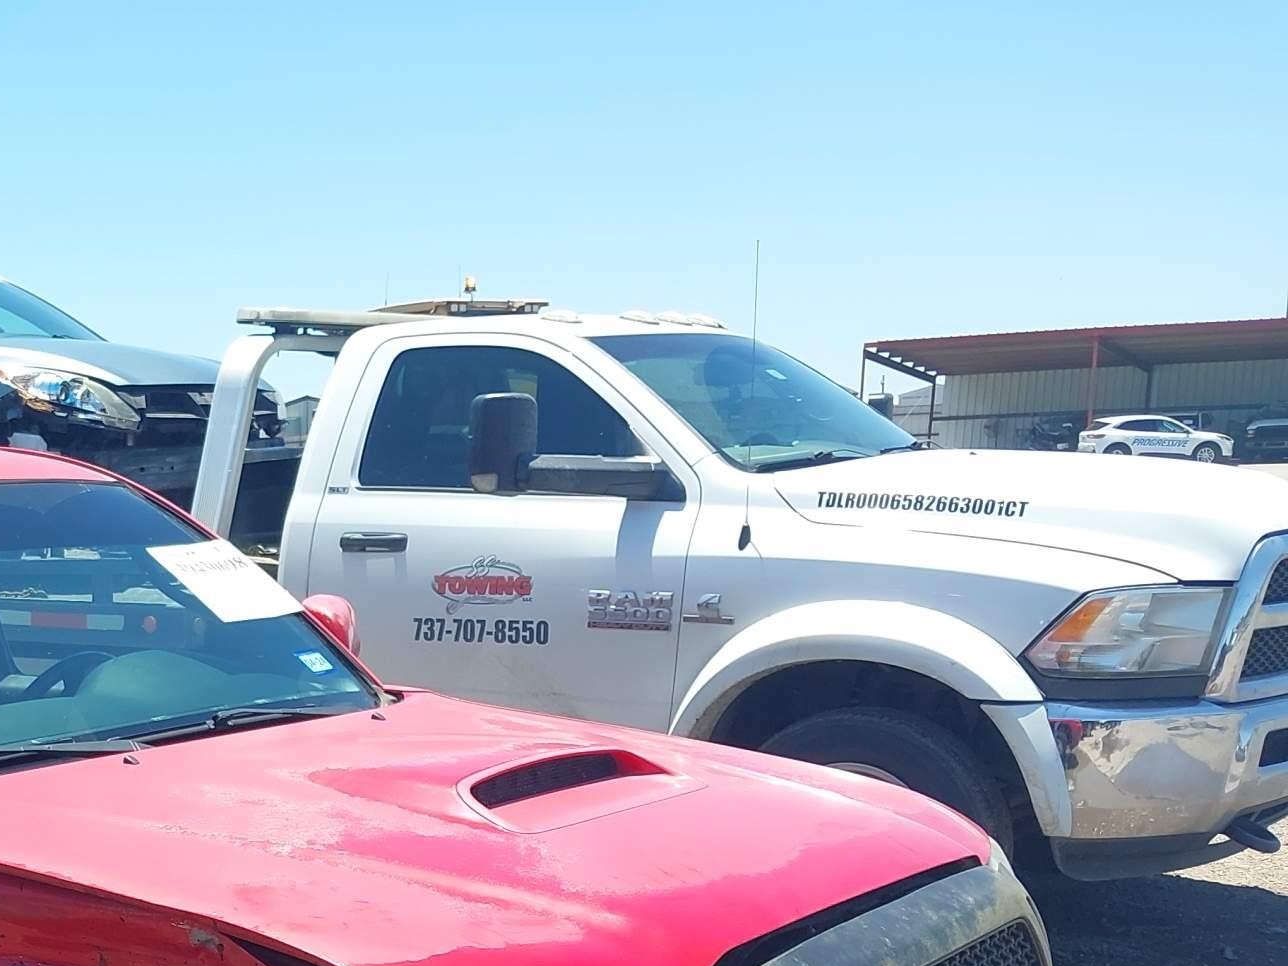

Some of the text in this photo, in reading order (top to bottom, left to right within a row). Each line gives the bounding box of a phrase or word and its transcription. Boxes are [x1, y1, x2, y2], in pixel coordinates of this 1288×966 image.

[1132, 438, 1189, 448] PROGRESSIVE
[817, 491, 1029, 517] TDLR0006582663001CT
[433, 575, 533, 596] TOWING
[588, 589, 674, 608] RAM
[412, 617, 550, 645] 737-707-8550
